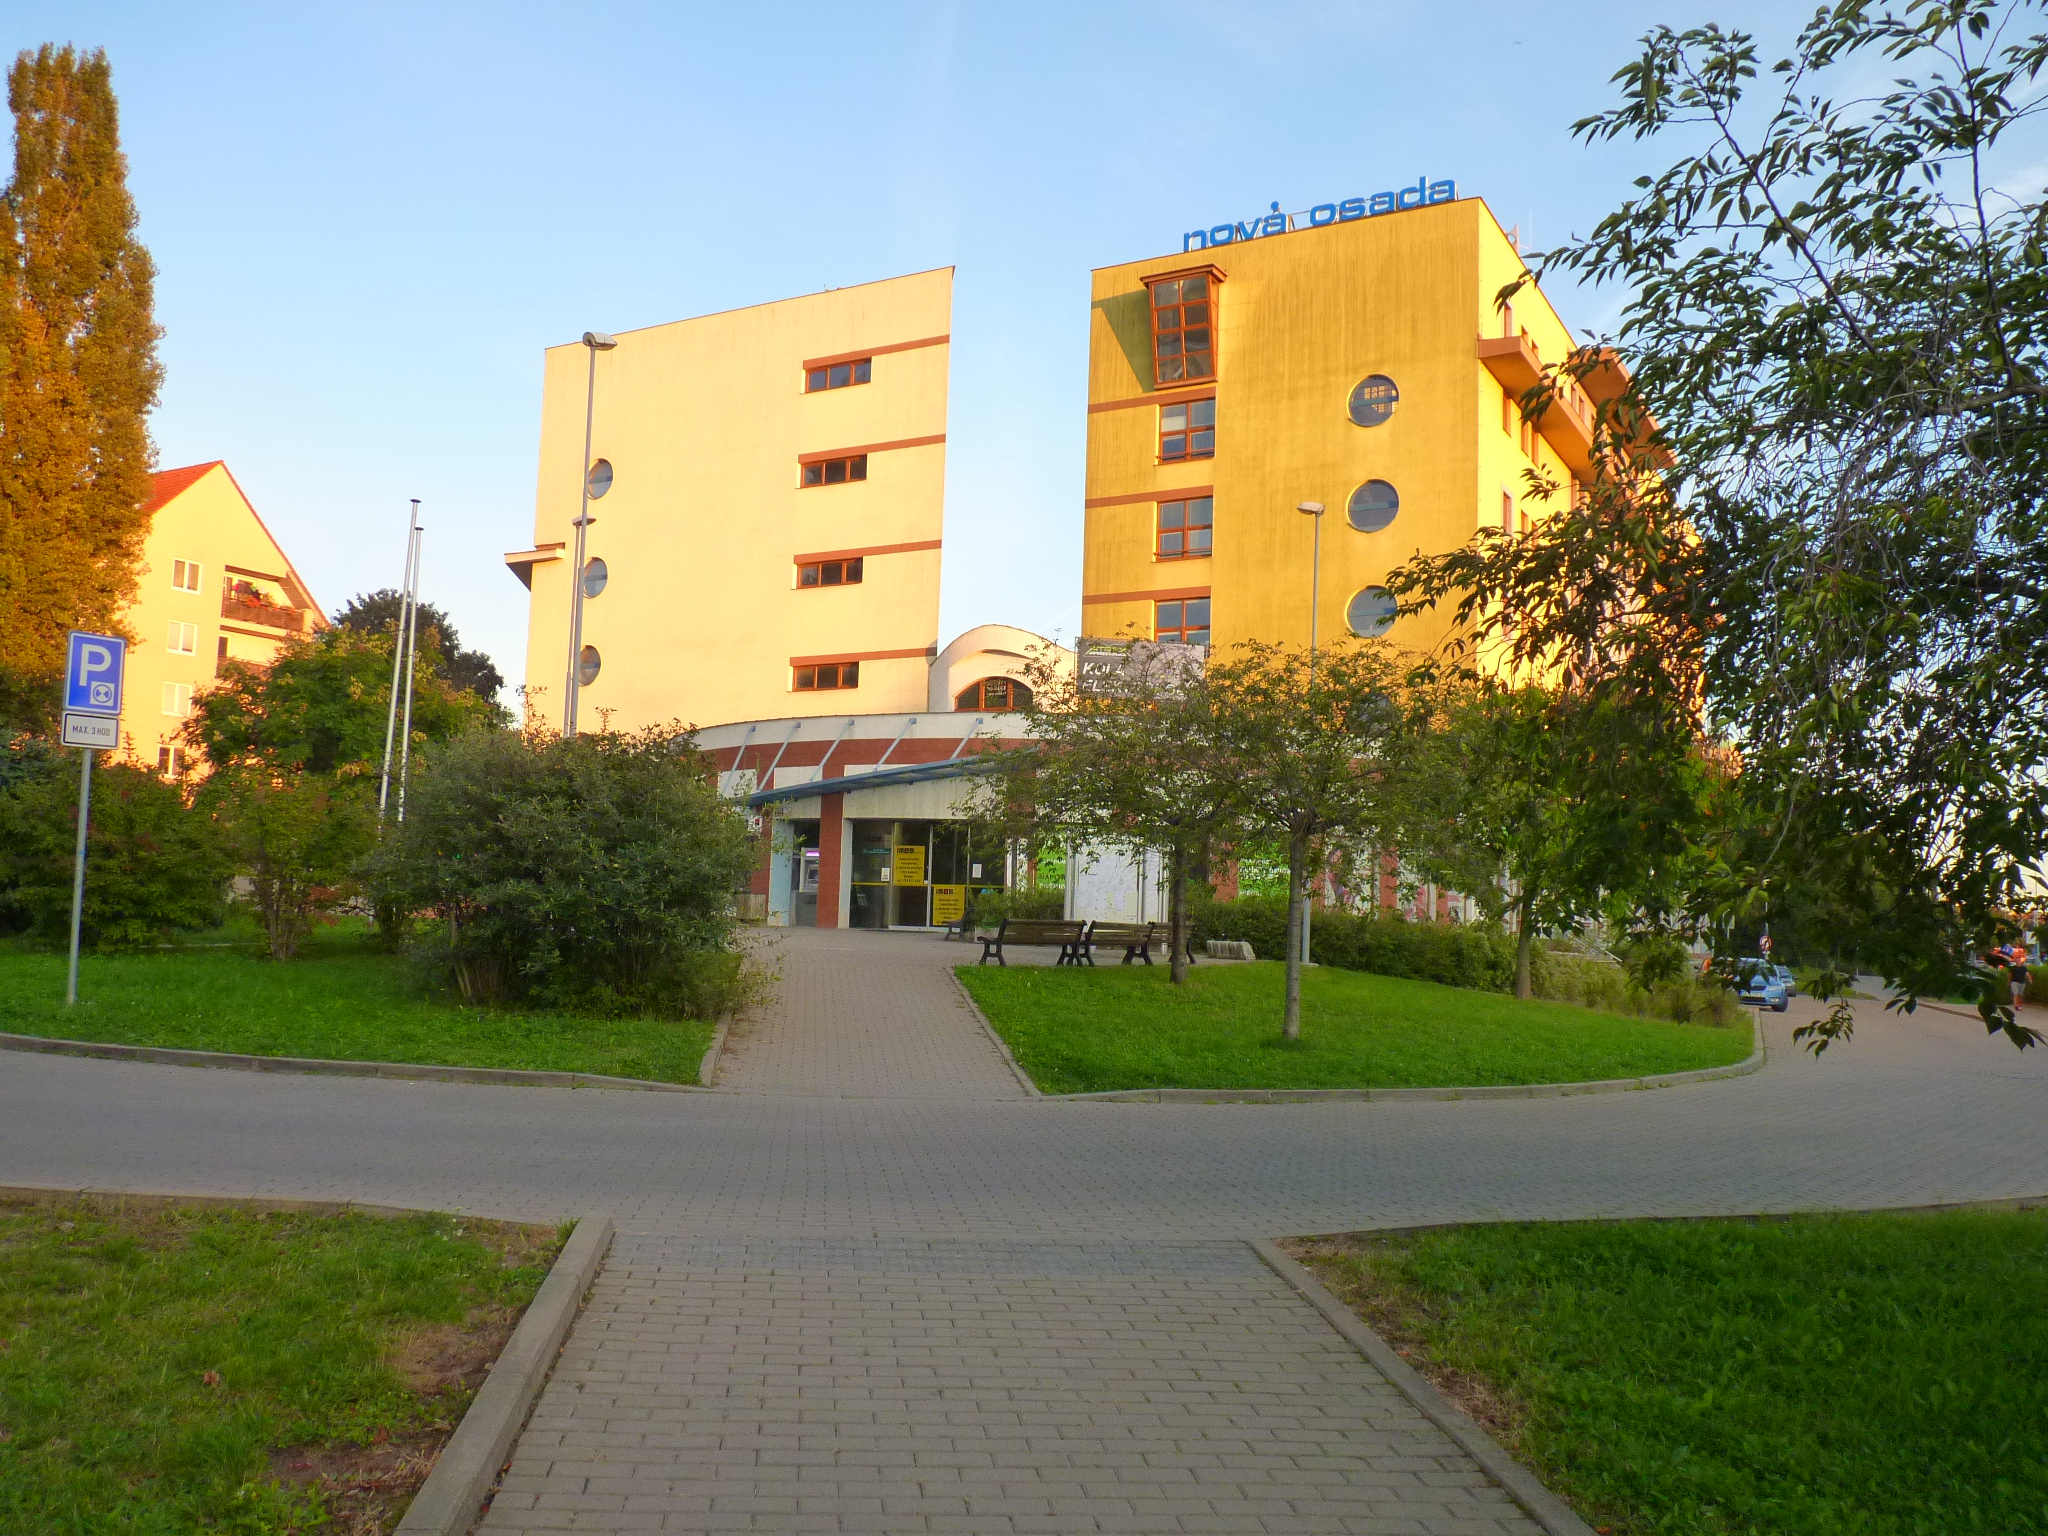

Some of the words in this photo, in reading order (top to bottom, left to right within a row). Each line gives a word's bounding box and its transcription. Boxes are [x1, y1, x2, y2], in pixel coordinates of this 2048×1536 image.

[1309, 176, 1458, 227] osada
[79, 643, 112, 686] P
[72, 724, 90, 735] MAX.
[91, 726, 96, 735] 3
[97, 727, 110, 736] HOD
